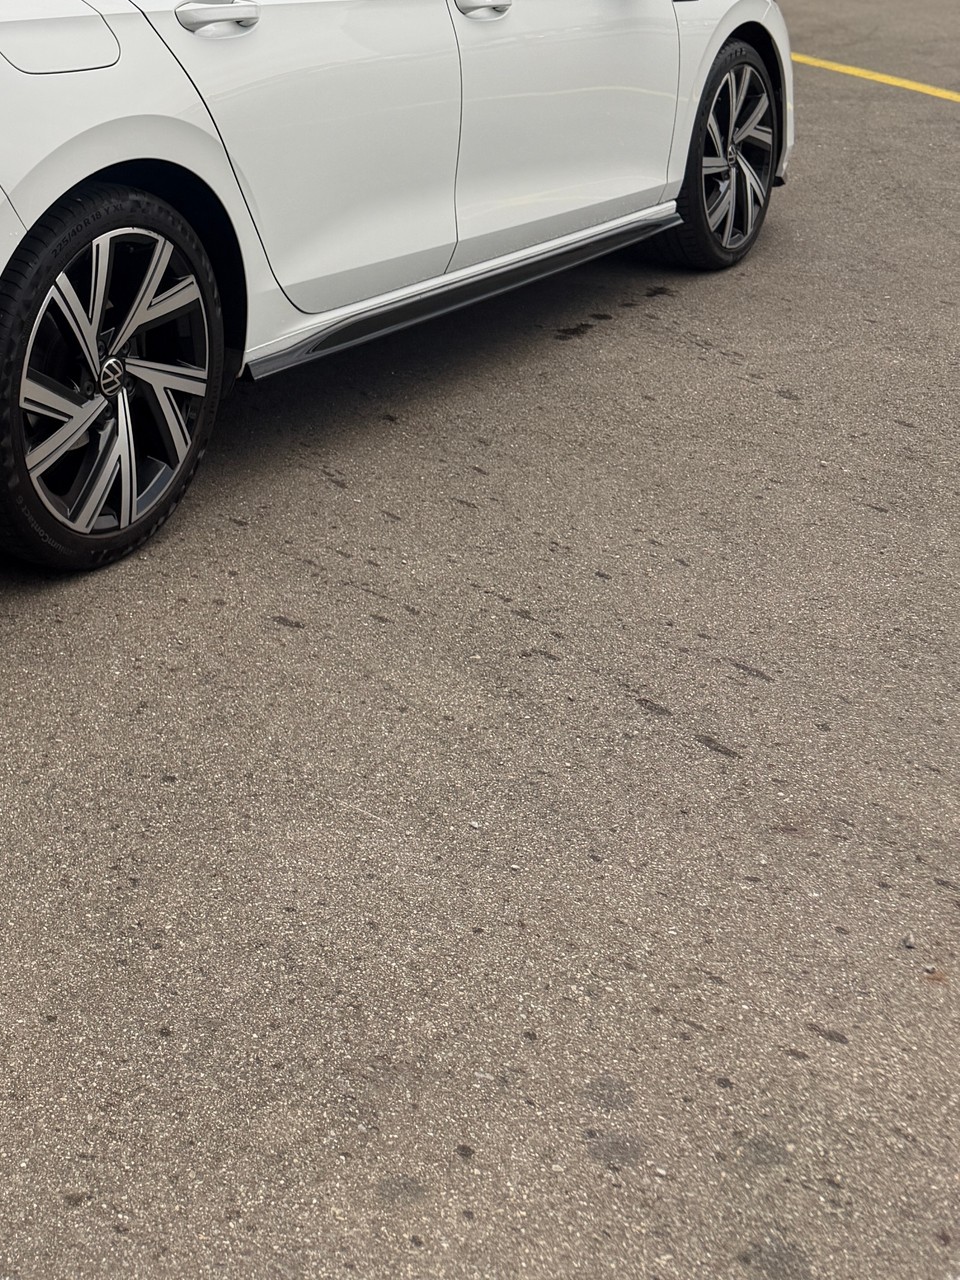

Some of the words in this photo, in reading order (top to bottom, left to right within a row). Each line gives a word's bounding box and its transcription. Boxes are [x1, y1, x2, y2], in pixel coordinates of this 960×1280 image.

[51, 224, 83, 258] 225/40
[83, 219, 92, 228] R
[91, 211, 103, 222] 18
